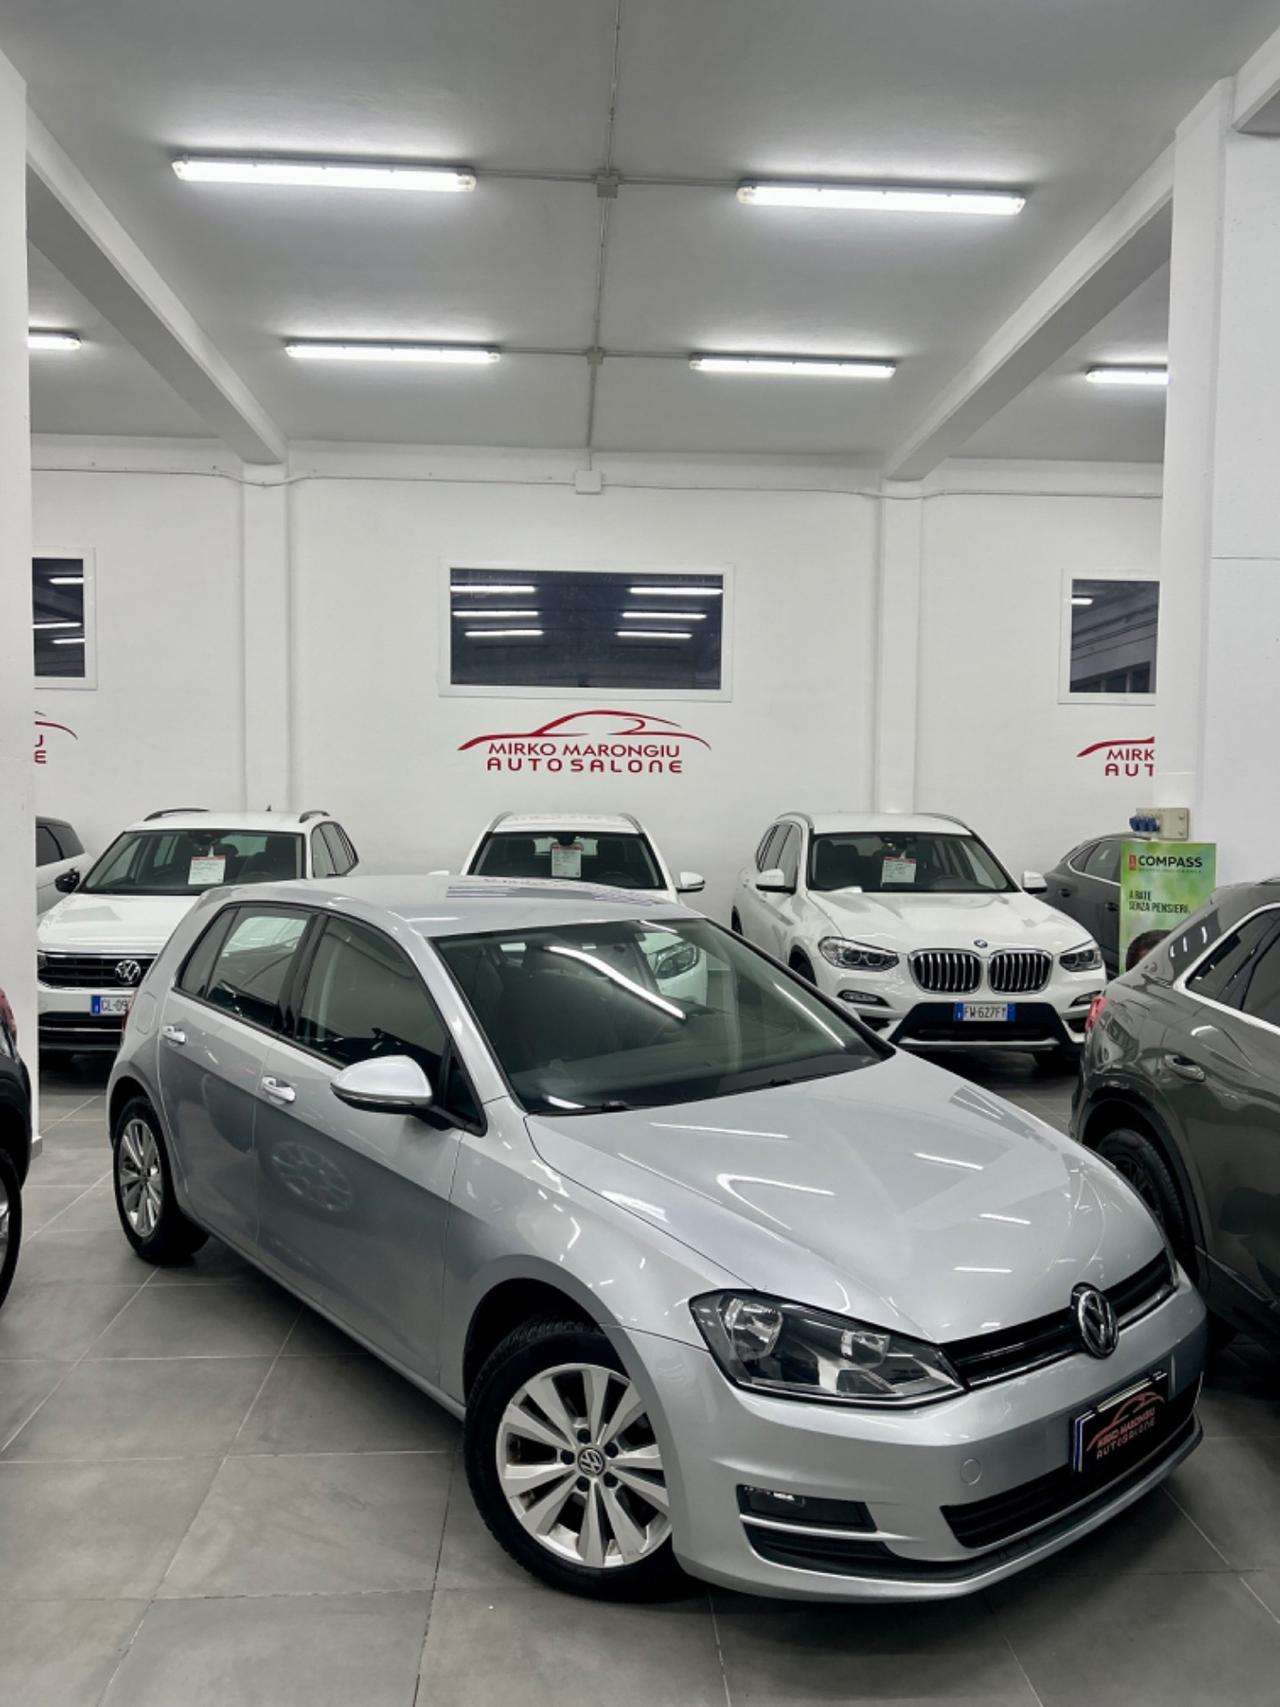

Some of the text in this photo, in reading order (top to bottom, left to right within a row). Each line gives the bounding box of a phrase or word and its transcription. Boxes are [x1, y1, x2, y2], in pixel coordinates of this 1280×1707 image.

[489, 742, 680, 758] MIRKO MARONGIU
[487, 757, 683, 774] AUTOSALONE
[1139, 855, 1202, 868] COMPASS
